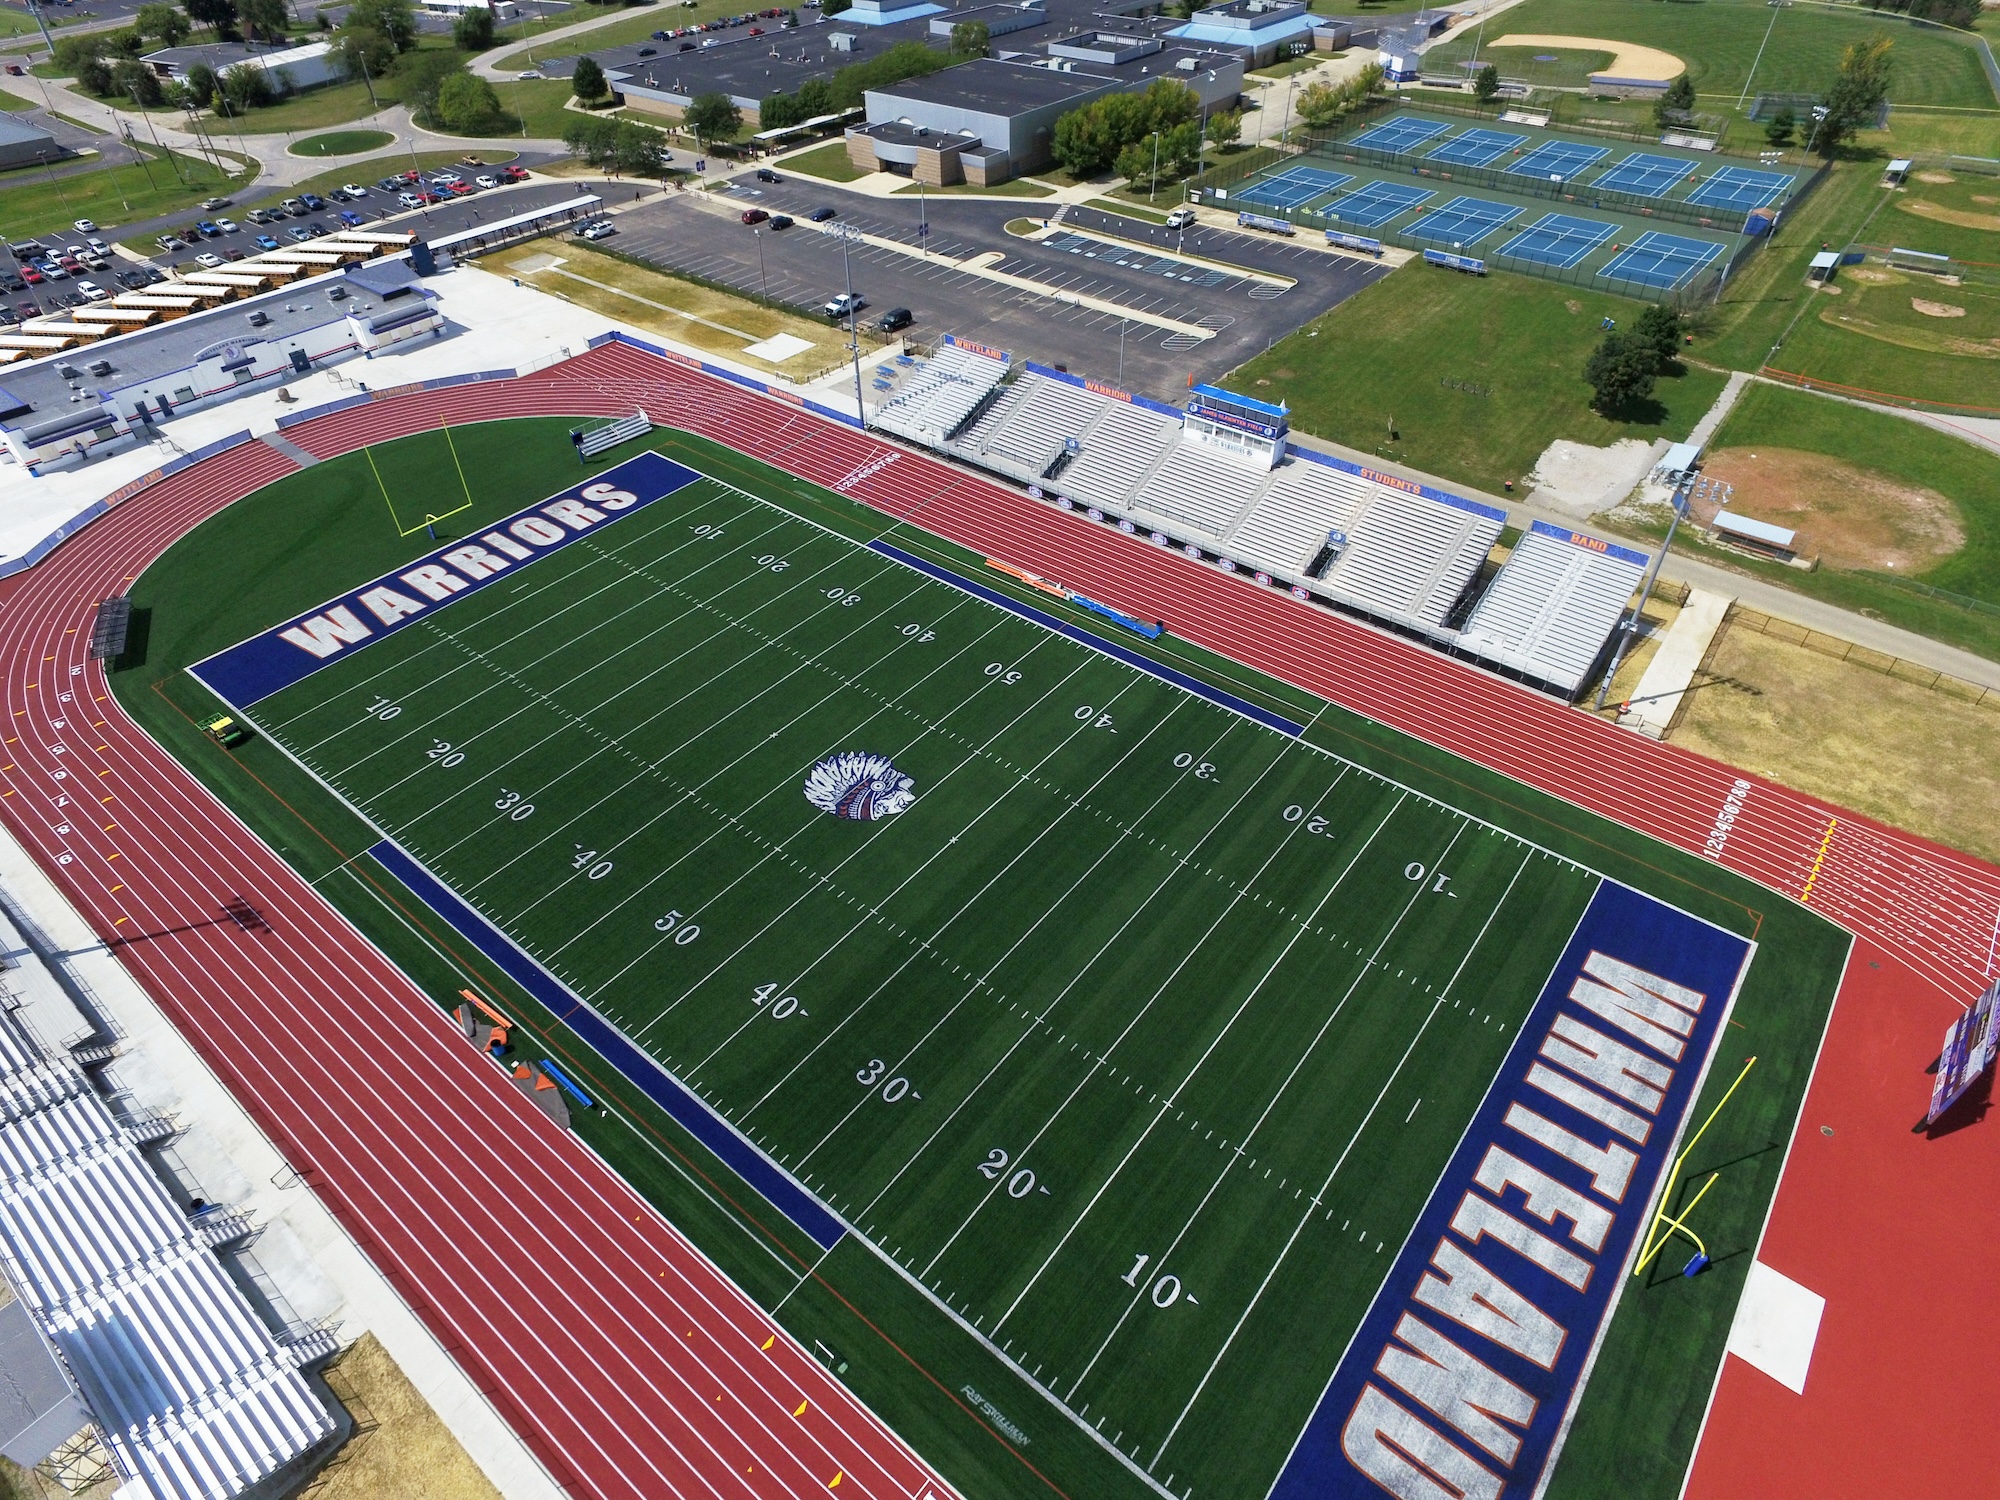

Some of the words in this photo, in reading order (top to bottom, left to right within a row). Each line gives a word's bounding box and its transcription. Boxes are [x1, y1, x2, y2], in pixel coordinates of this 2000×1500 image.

[664, 350, 703, 370] WHITELAND
[954, 337, 1002, 360] WHITELAND
[371, 383, 424, 400] WARRIORS
[766, 386, 805, 406] WARRIORS
[1084, 381, 1132, 403] WARRIORS
[1247, 422, 1263, 432] FIELD
[104, 469, 164, 507] WHITELAND
[1360, 468, 1421, 495] STUDENTS
[694, 524, 725, 540] 10
[1570, 533, 1608, 552] BAND
[278, 481, 640, 660] WARRIORS
[757, 554, 790, 572] 20
[827, 587, 861, 607] 30
[902, 623, 936, 643] 40
[984, 662, 1022, 686] 50
[366, 699, 402, 721] 10
[1074, 705, 1113, 728] 40
[425, 742, 465, 768] 20
[1173, 752, 1216, 779] 30
[495, 792, 535, 821] 30
[1282, 804, 1330, 834] 20
[571, 850, 613, 880] 40
[1404, 861, 1451, 893] 10
[654, 909, 701, 945] 50
[750, 981, 799, 1019] 40
[856, 1058, 910, 1103] 30
[977, 1148, 1036, 1198] 20
[1341, 950, 1707, 1500] WHITELAND
[1121, 1253, 1182, 1308] 10
[960, 1384, 986, 1406] RAY
[980, 1402, 1031, 1446] SKILLMAN
